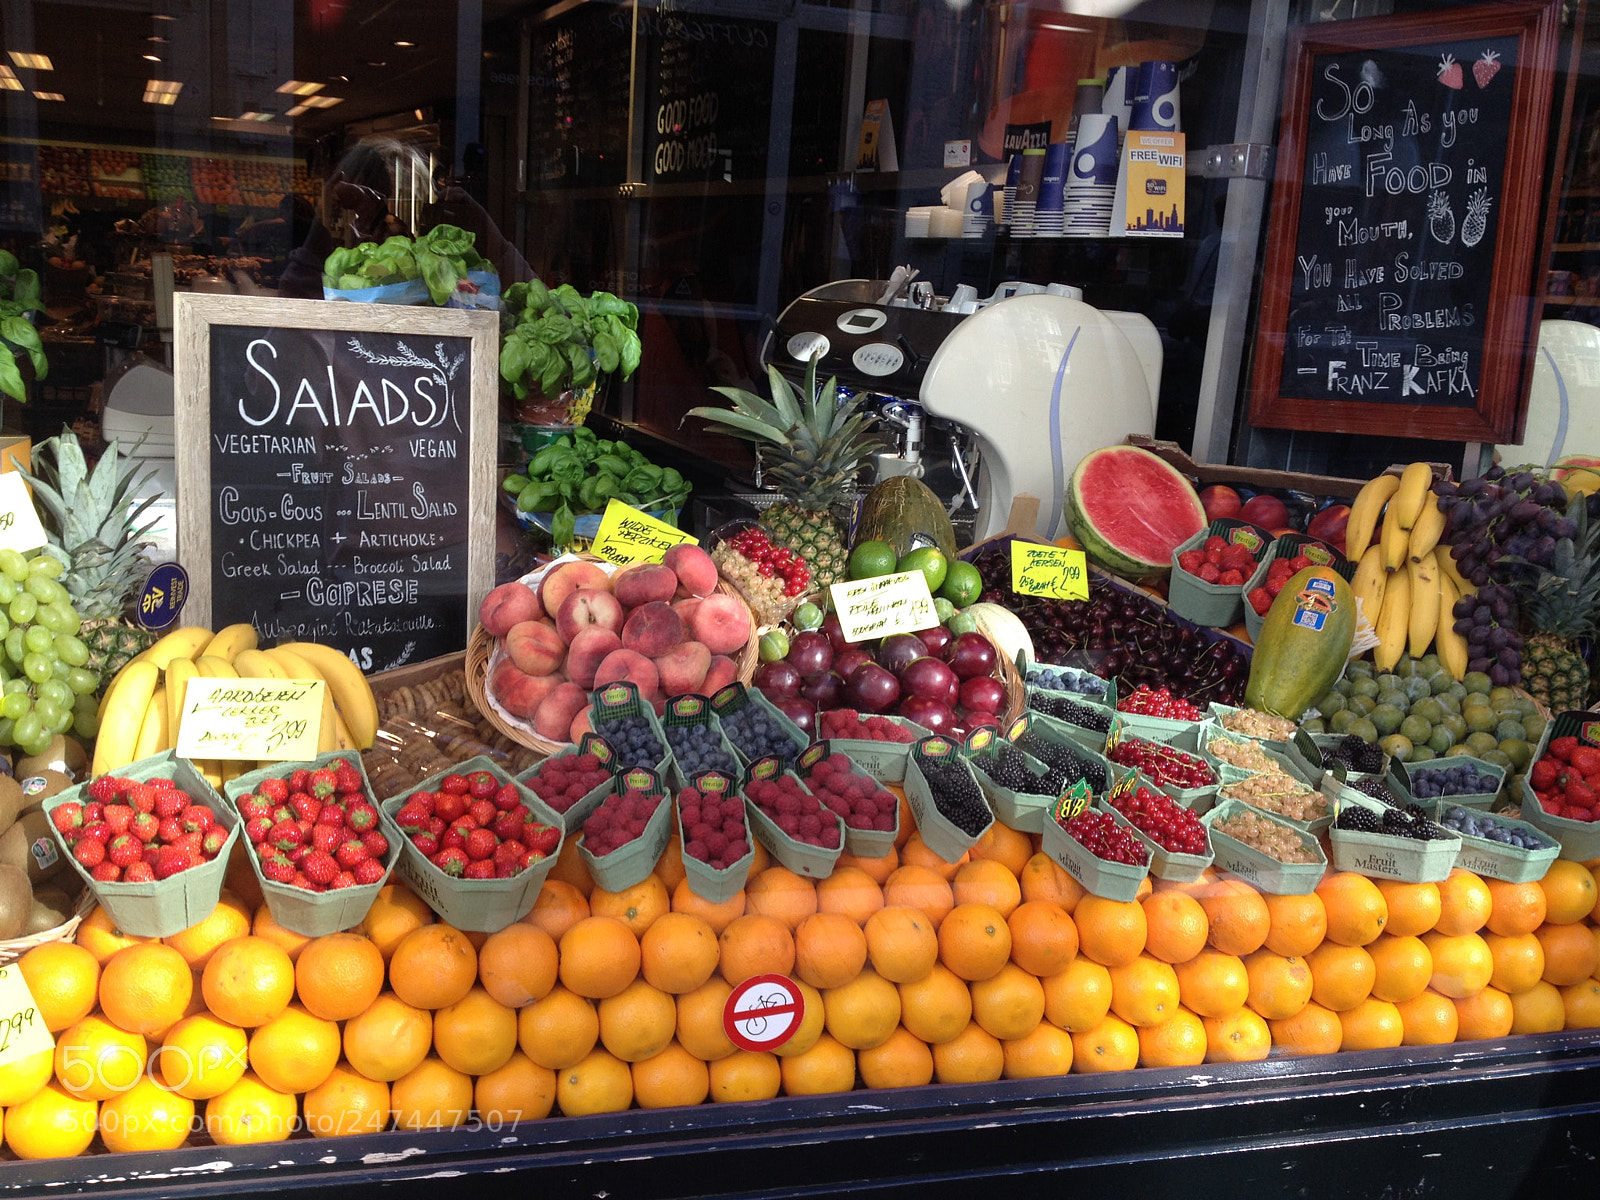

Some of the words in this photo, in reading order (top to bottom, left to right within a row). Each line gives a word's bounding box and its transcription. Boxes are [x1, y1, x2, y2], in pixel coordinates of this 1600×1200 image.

[657, 100, 686, 134] GOOD
[1004, 129, 1048, 149] LAVAZZA
[655, 141, 685, 175] GOOD
[1130, 150, 1157, 160] FREE
[1159, 154, 1183, 166] WIFI
[1312, 152, 1352, 184] HAVE
[1366, 152, 1452, 197] FOOD
[1298, 254, 1332, 290] YOU
[1345, 259, 1384, 288] HAVE
[1394, 252, 1463, 282] SOLVED
[1379, 292, 1474, 330] PROBLEMS
[1356, 342, 1401, 367] TIME
[1327, 361, 1390, 395] FRANZ
[214, 434, 316, 454] VEGETARIAN
[409, 439, 457, 459] VEGAN
[357, 489, 409, 520] LENTIL
[411, 481, 458, 520] SALAD
[250, 530, 321, 550] CHICKPEA
[221, 551, 271, 578] Greek
[277, 554, 321, 576] Salad
[354, 555, 404, 575] Broccoli
[411, 554, 452, 571] Salad
[1030, 559, 1066, 567] KERSEN
[702, 779, 724, 789] Prestige
[1369, 854, 1396, 867] Fruit
[1474, 856, 1498, 869] Fruit
